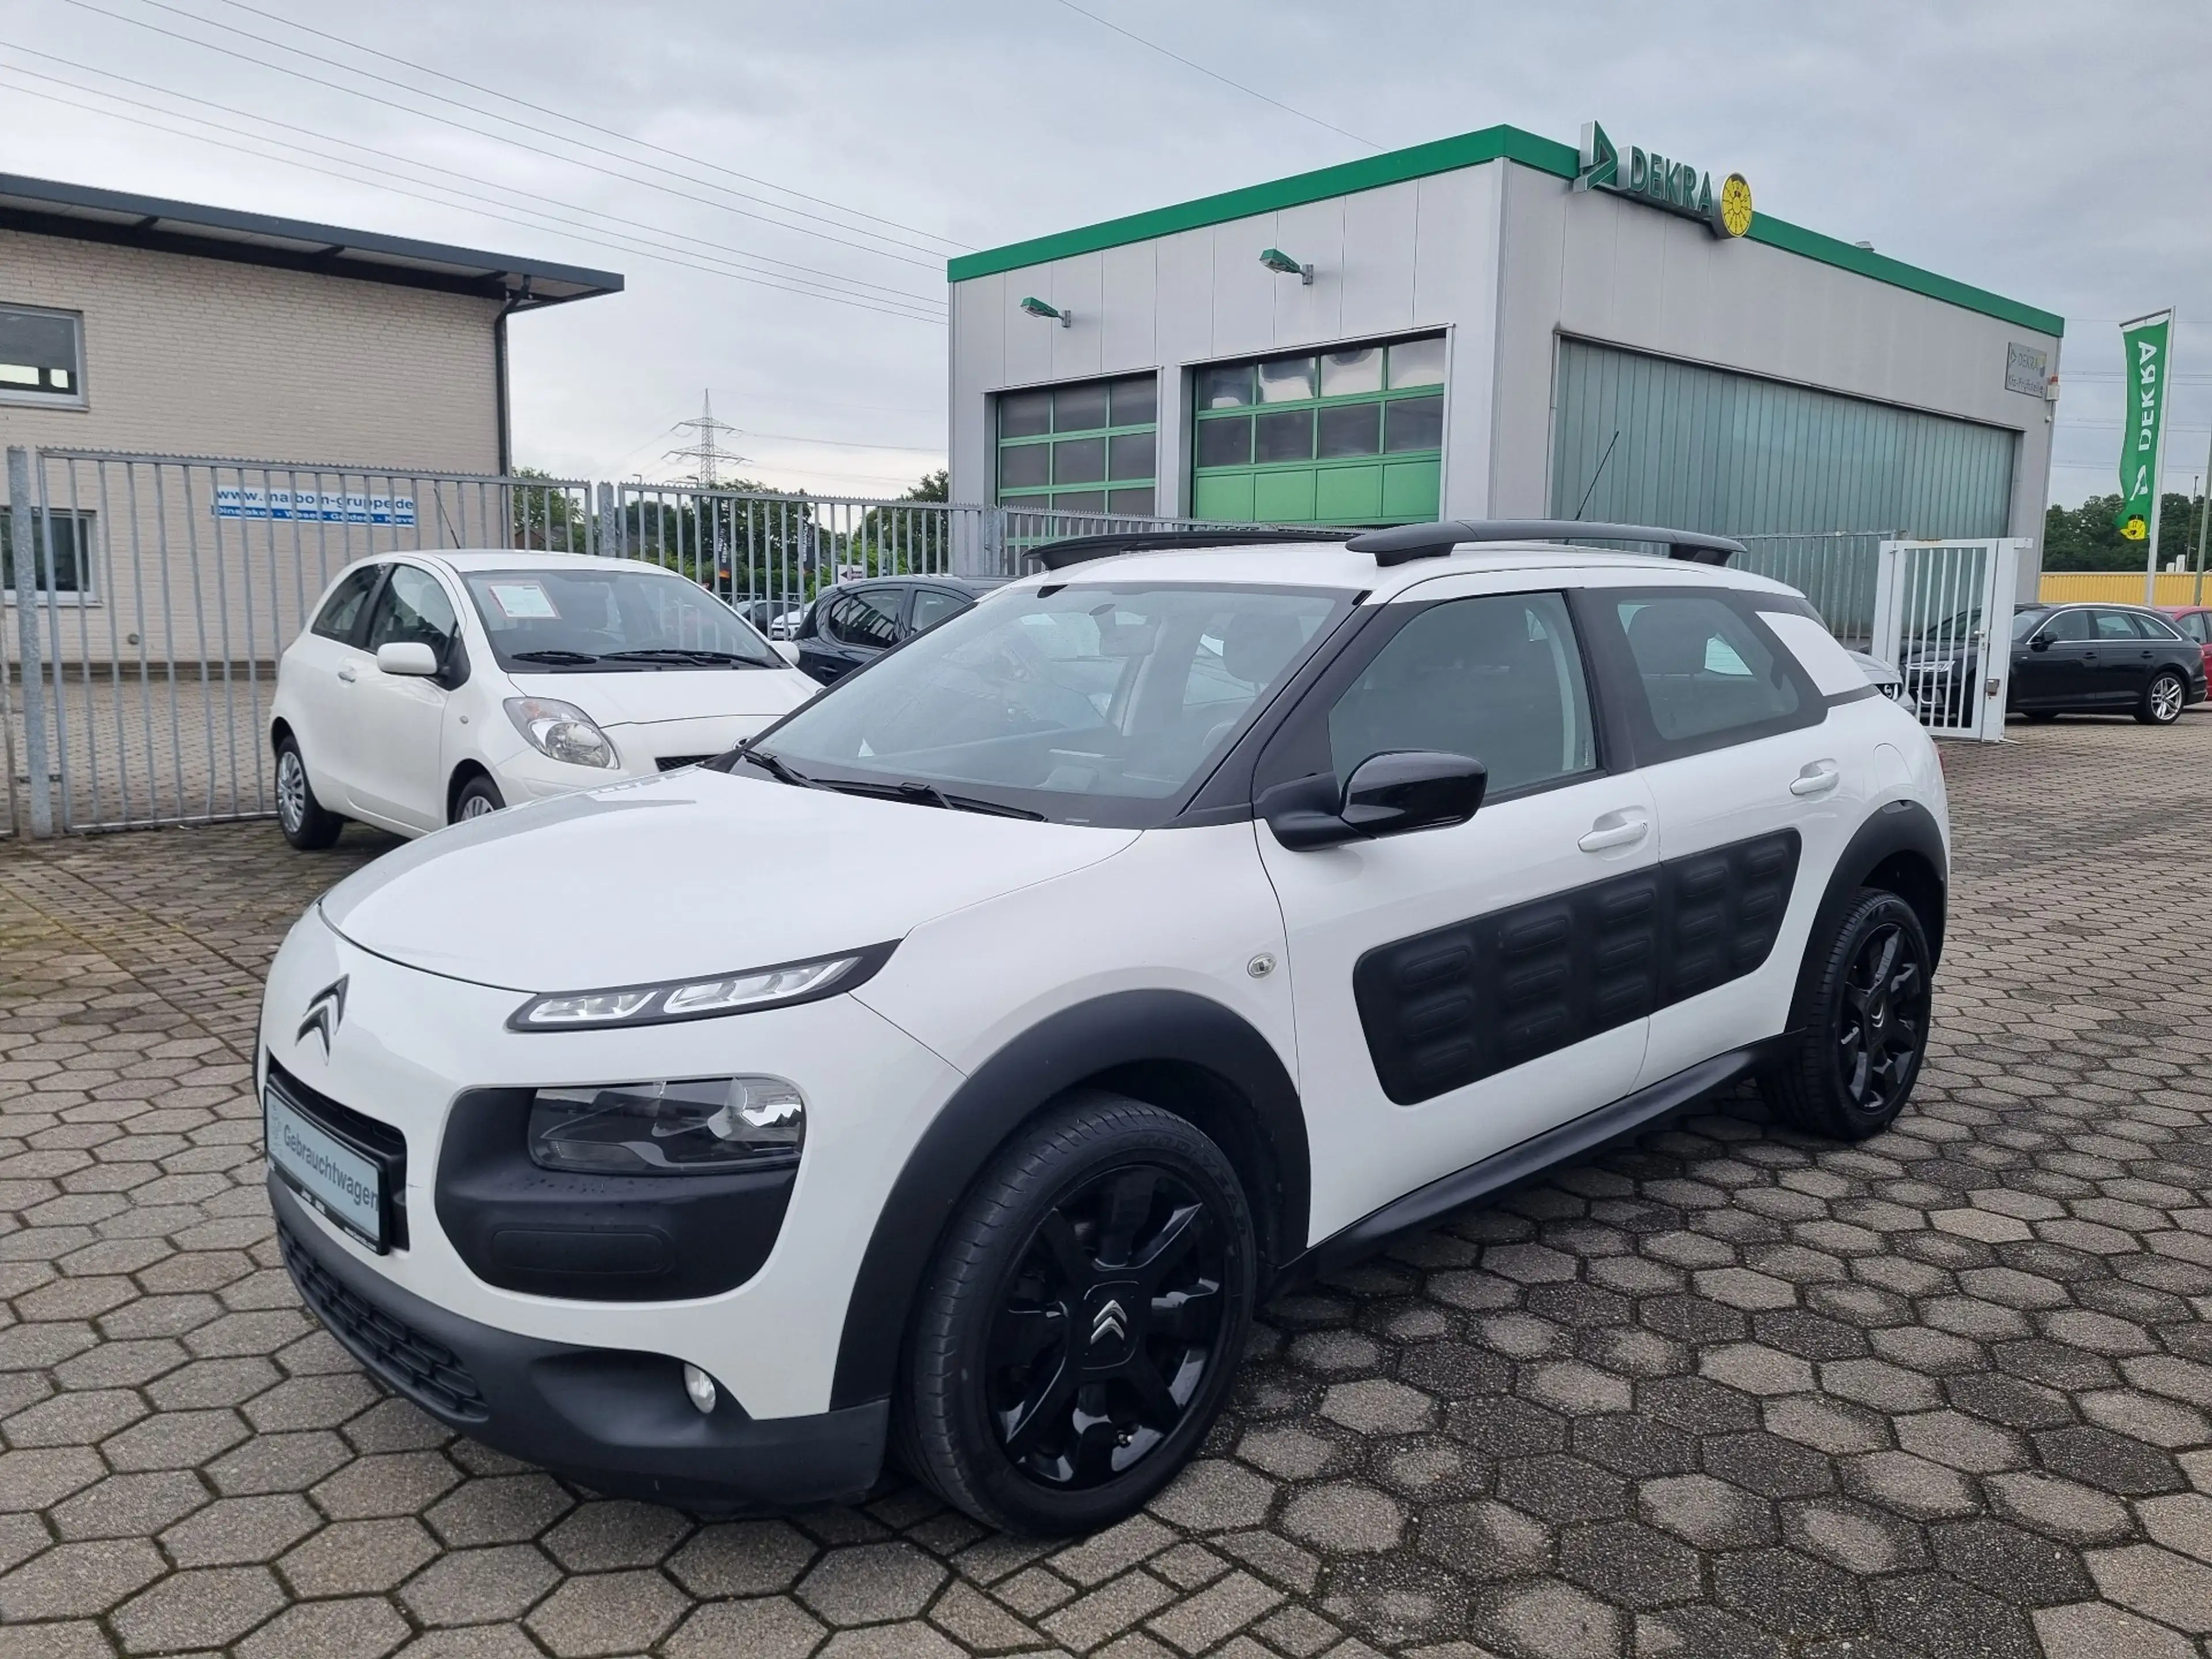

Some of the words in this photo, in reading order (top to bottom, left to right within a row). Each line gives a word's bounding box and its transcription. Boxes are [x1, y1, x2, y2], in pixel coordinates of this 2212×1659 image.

[1628, 145, 1715, 217] DEKRA
[216, 490, 414, 510] www.mabom-gruppede
[283, 1123, 379, 1213] Gebrauchtwagen
